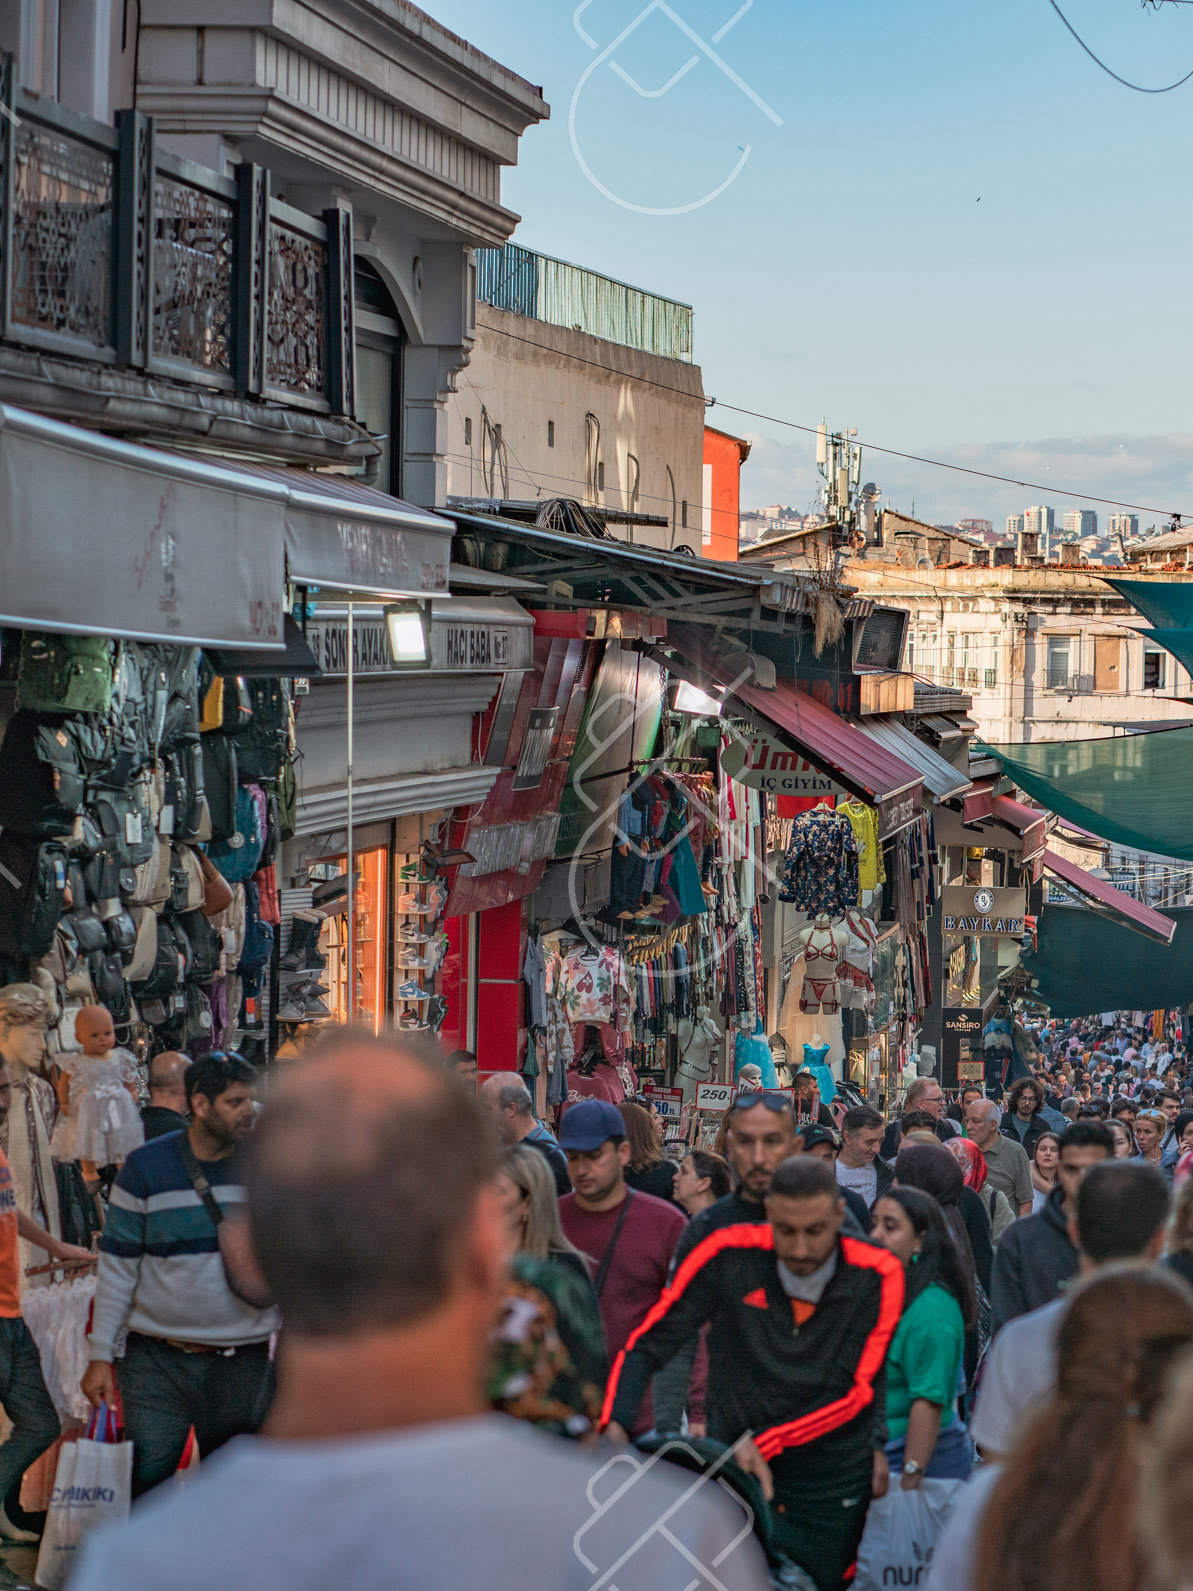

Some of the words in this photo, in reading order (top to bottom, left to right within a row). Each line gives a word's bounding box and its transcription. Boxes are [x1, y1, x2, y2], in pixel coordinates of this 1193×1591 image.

[447, 628, 467, 664] HACI
[470, 629, 491, 663] BABA
[760, 774, 777, 790] İÇ
[782, 775, 832, 790] GİYİM
[943, 916, 1023, 933] BAYKAR
[945, 1021, 980, 1029] SANSIRO
[700, 1089, 728, 1101] 250
